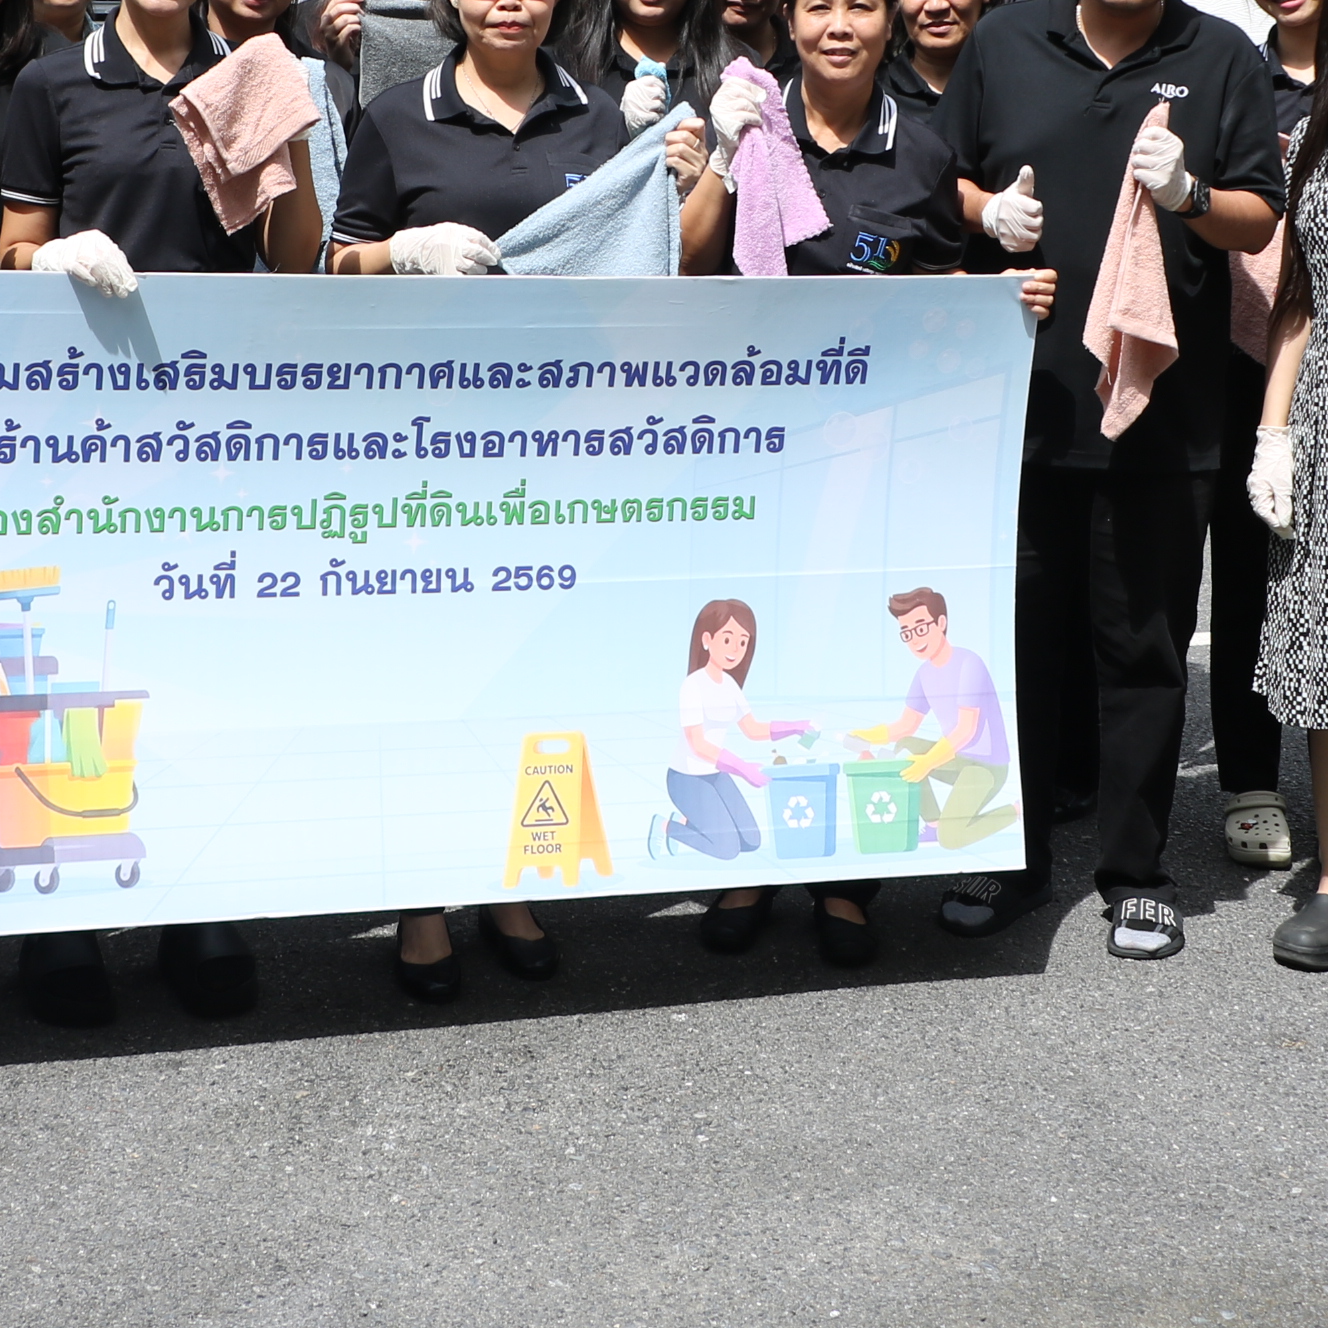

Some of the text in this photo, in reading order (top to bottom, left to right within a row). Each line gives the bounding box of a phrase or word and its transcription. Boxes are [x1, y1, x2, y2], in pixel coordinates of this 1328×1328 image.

[850, 231, 888, 262] 51
[154, 551, 577, 600] วันที่ 22 กันยายน 2569
[524, 764, 574, 776] CAUTION
[531, 831, 556, 841] WET
[523, 843, 562, 855] FLOOR
[1121, 897, 1177, 926] FER
